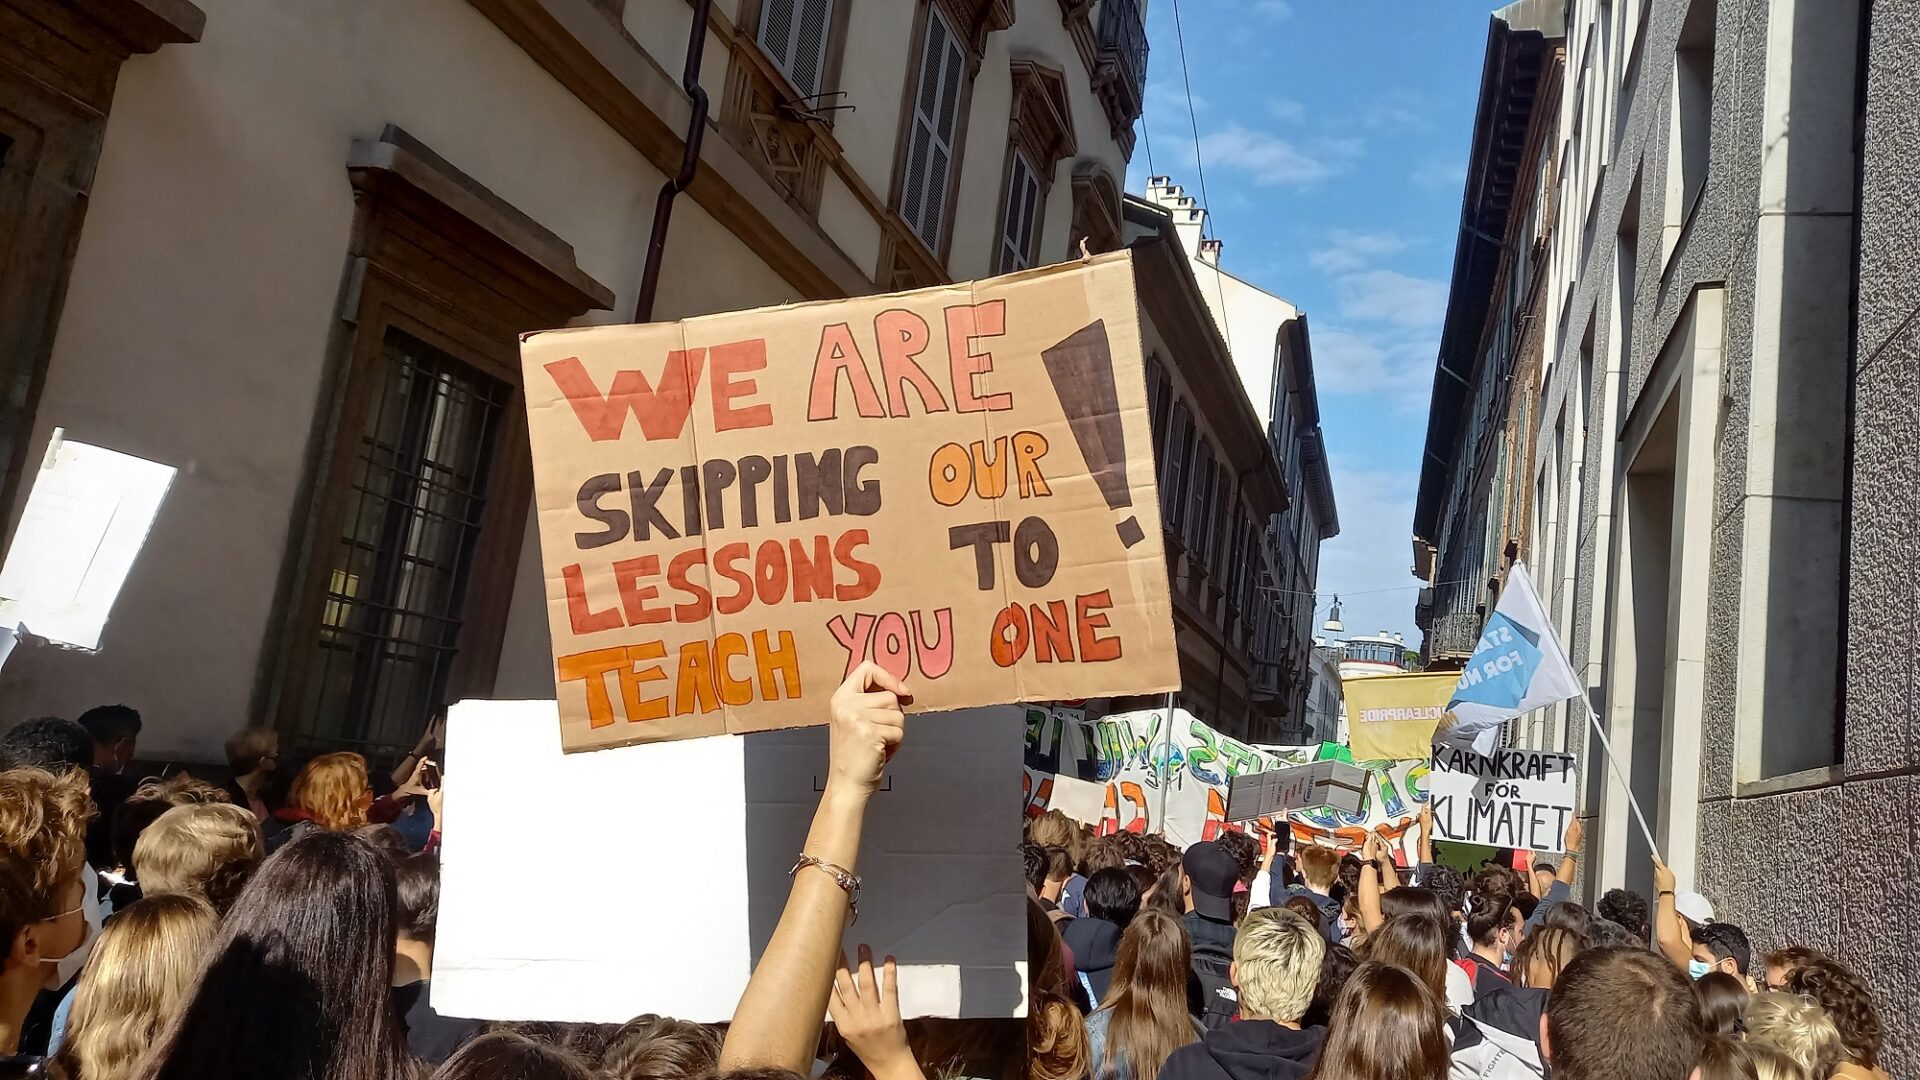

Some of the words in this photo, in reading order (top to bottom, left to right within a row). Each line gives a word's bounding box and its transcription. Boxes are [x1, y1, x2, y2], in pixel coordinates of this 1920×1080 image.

[543, 338, 773, 441] WE
[807, 299, 1013, 422] ARE
[575, 445, 882, 549] SKIPPING
[929, 431, 1052, 506] OUR
[563, 529, 882, 635] LESSONS
[949, 516, 1059, 590] TO
[558, 629, 802, 729] TEACH
[827, 607, 952, 686] YOU
[990, 590, 1122, 667] ONE
[1430, 794, 1572, 852] KLIMATET
[1485, 781, 1520, 799] FÖR
